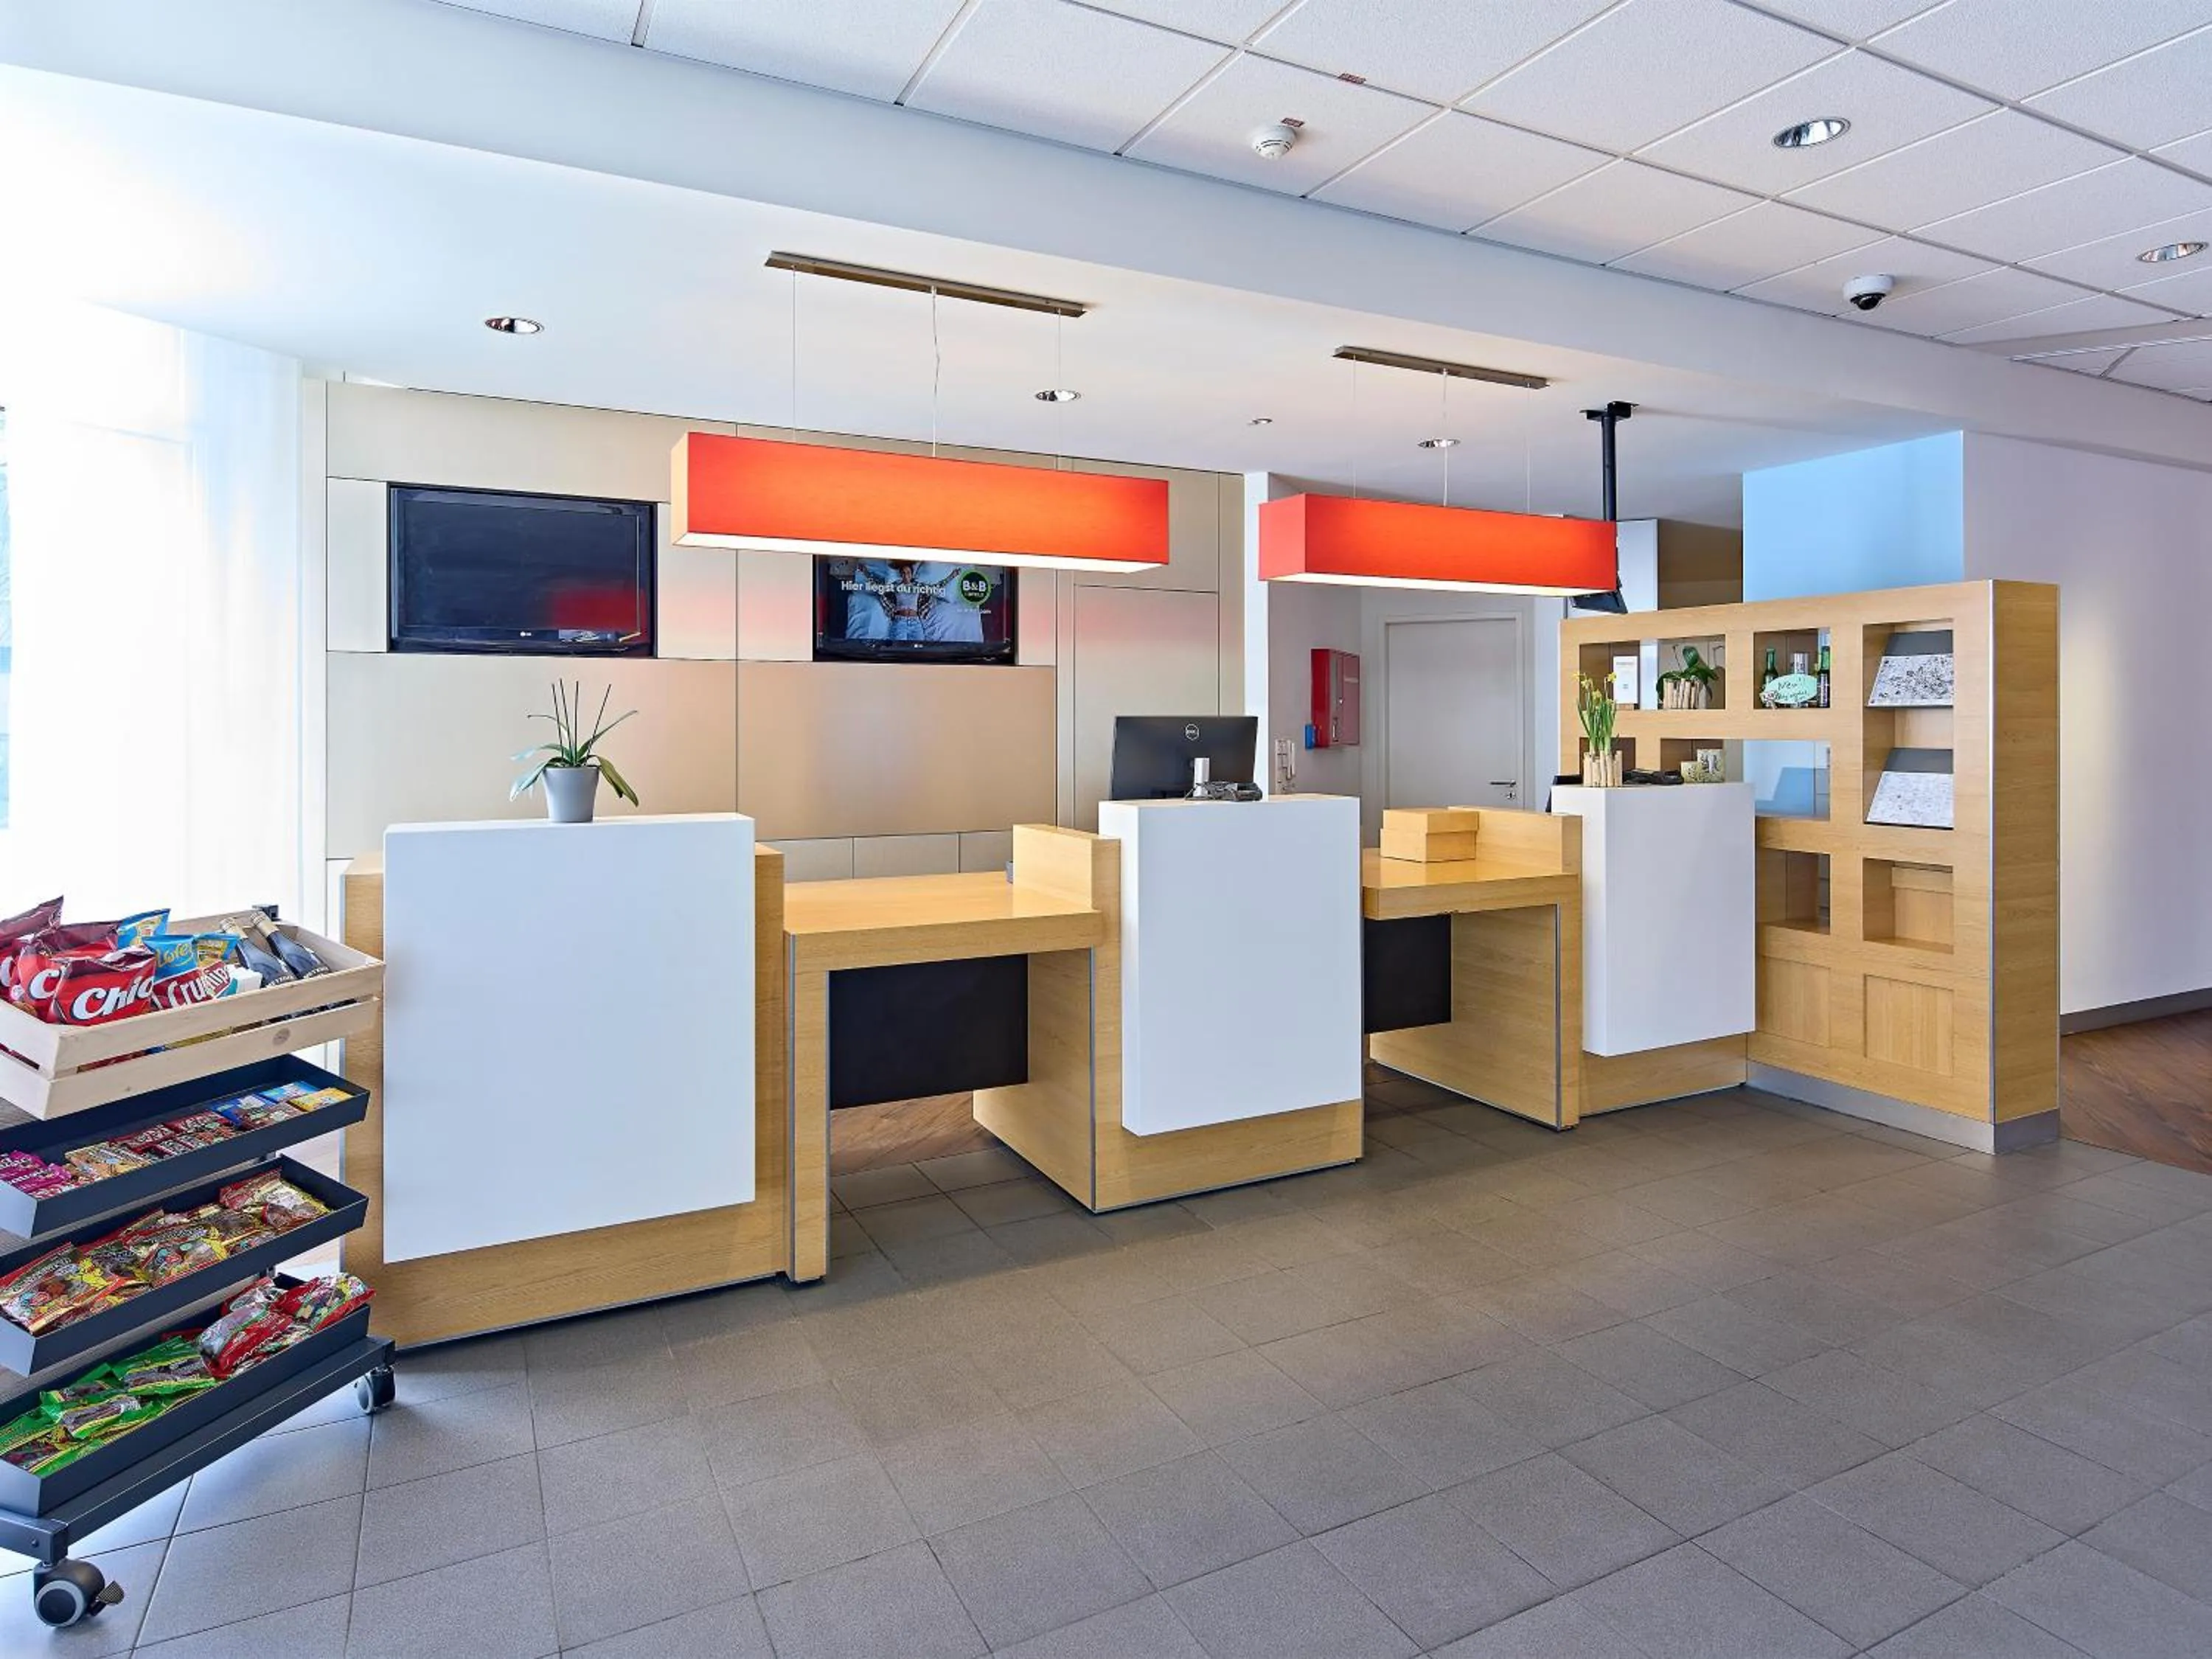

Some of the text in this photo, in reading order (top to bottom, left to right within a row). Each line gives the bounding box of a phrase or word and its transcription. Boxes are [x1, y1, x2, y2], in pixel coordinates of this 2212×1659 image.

[841, 580, 946, 597] Hier liegst du richtig
[962, 580, 987, 592] B&B
